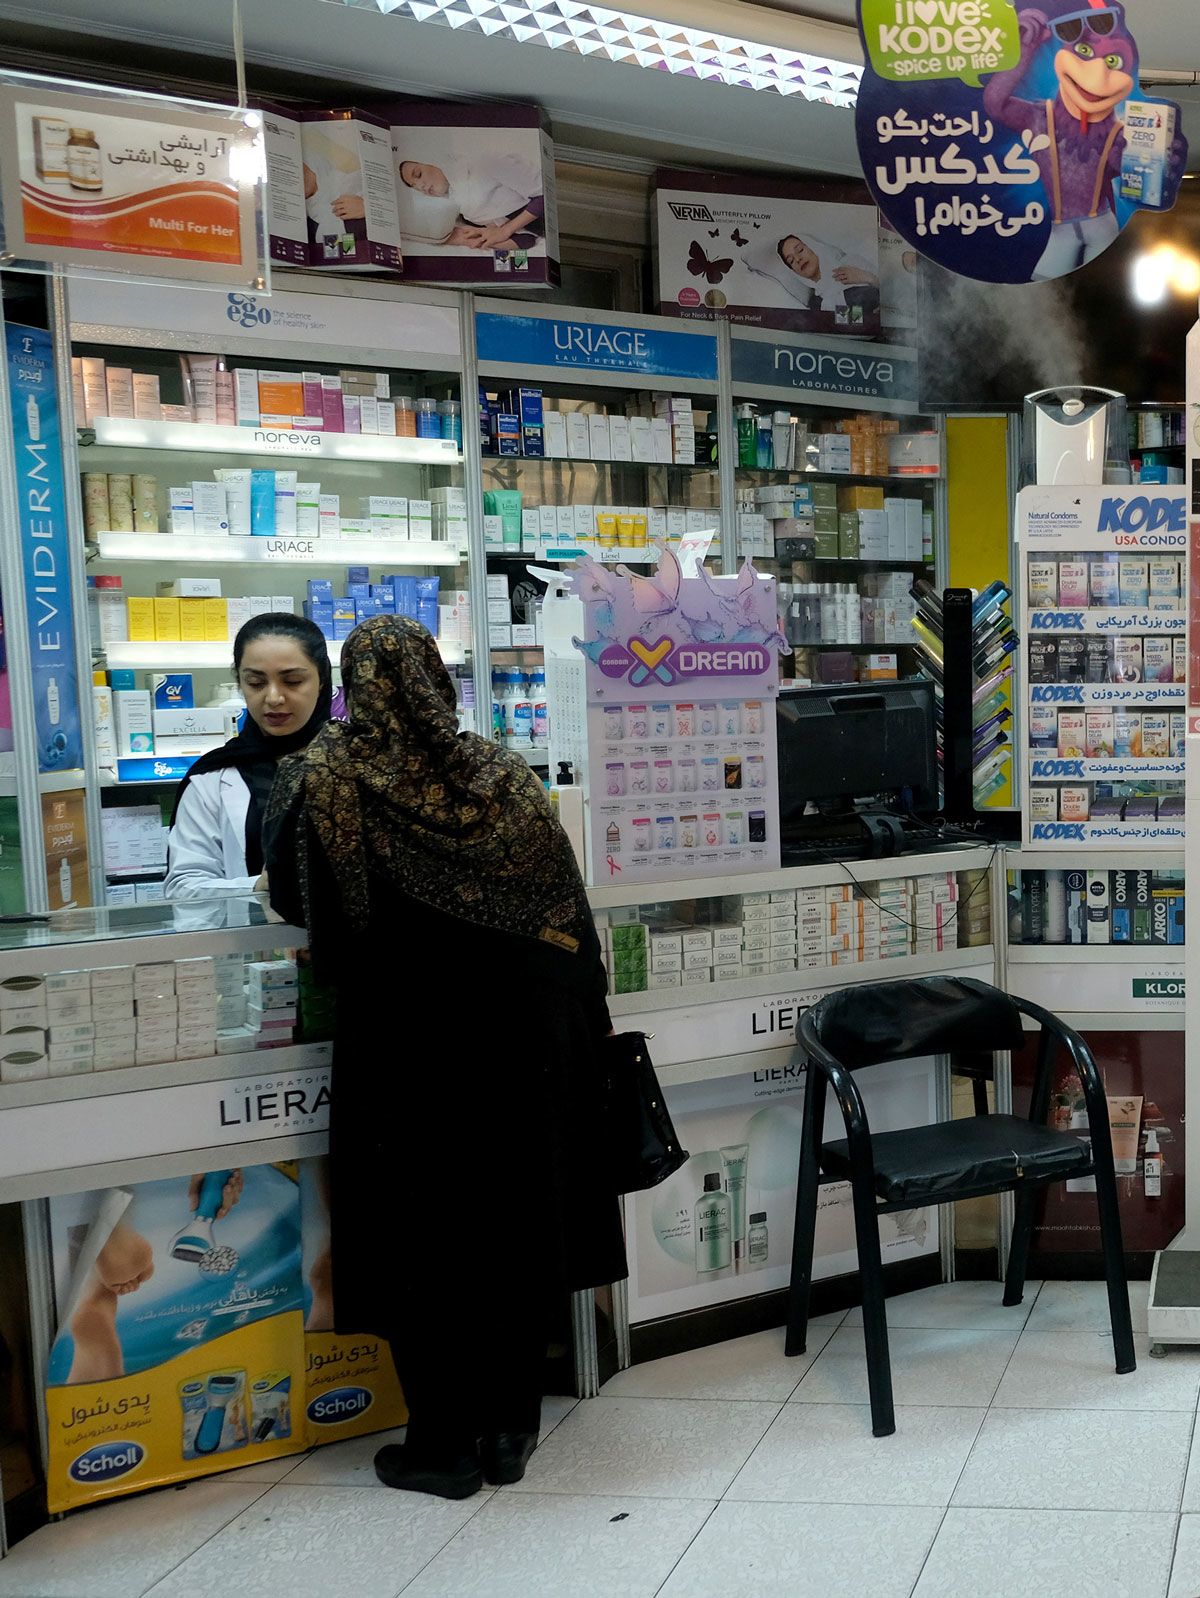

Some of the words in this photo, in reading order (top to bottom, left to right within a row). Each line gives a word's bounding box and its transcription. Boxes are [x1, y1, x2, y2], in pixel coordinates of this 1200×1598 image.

[160, 134, 228, 158] آرایشی
[108, 149, 190, 175] بهداشتی
[875, 142, 1041, 195] کدکس
[670, 203, 713, 221] VERNA
[712, 209, 748, 219] BUTTERFLY
[748, 212, 772, 221] PILLOW
[149, 216, 185, 234] Multi
[187, 221, 209, 235] For
[211, 225, 236, 238] Her
[226, 303, 271, 329] ego
[273, 310, 286, 318] the
[287, 311, 312, 321] science
[273, 318, 283, 326] of
[282, 319, 309, 331] healthy
[680, 310, 692, 320] For
[692, 311, 708, 320] Neck
[708, 312, 715, 320] &
[714, 312, 730, 322] Back
[730, 313, 744, 322] Pain
[744, 313, 763, 323] Relief
[552, 324, 647, 357] URIAGE
[555, 354, 577, 363] EAU
[584, 357, 648, 369] THERMALE
[773, 347, 894, 384] noreva
[792, 378, 878, 396] LABORATOIRES
[253, 430, 322, 446] noreva
[1028, 512, 1050, 520] Natural
[1050, 512, 1079, 520] Condoms
[1097, 496, 1186, 533] KODE
[24, 443, 62, 652] EVIDERM
[266, 540, 314, 555] URIAGE
[1115, 535, 1138, 546] USA
[1031, 612, 1084, 630] KODEX
[1096, 614, 1138, 629] آمریکایی
[1139, 614, 1163, 629] بزرگ
[601, 658, 629, 666] CONDOM
[679, 650, 765, 672] DREAM
[166, 685, 182, 696] QV
[1031, 685, 1084, 703] KODEX
[1091, 689, 1106, 700] زن
[1114, 690, 1131, 700] مرد
[1132, 690, 1145, 700] در
[1145, 689, 1161, 702] اوج
[1161, 688, 1186, 698] نقطه
[1031, 759, 1085, 778] KODEX
[1088, 763, 1118, 774] عفونت
[1124, 763, 1165, 774] حساسیت
[1031, 822, 1086, 842] KODEX
[1090, 827, 1118, 838] کاندوم
[1118, 829, 1141, 838] جنس
[1115, 869, 1127, 903] ARKO
[1154, 902, 1166, 940] ARKO
[753, 1062, 809, 1084] LIERA
[219, 1085, 333, 1127] LIERA
[273, 1118, 315, 1129] PARIS
[699, 1207, 727, 1220] LIERAC
[61, 1395, 110, 1429] شول
[313, 1391, 366, 1418] Scholl
[77, 1445, 138, 1475] Scholl
